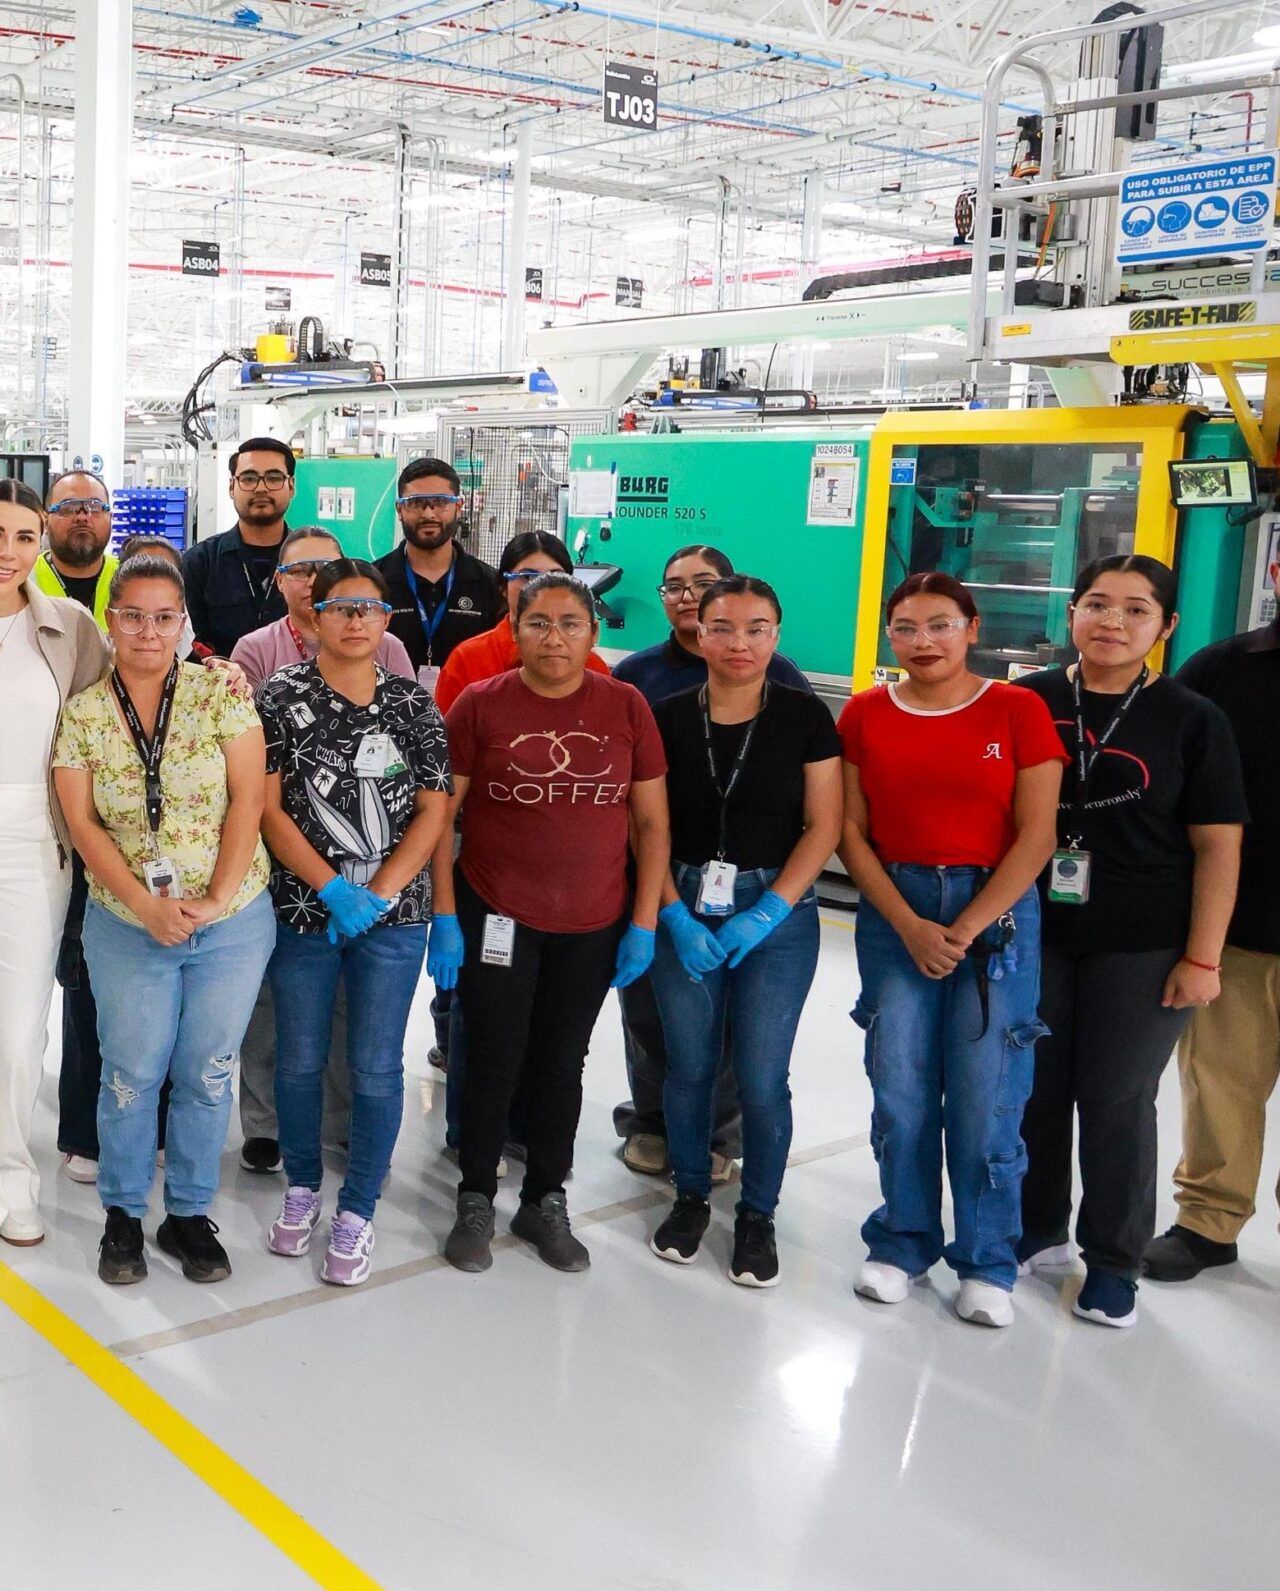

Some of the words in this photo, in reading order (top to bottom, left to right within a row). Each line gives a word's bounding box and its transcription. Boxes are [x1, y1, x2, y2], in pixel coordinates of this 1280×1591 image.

[606, 91, 654, 124] TJ03
[1128, 180, 1149, 189] USO
[1152, 168, 1226, 186] OBLIGATORIO
[1230, 166, 1245, 174] DE
[1248, 162, 1270, 172] EPP
[1128, 189, 1155, 200] PARA
[1158, 184, 1192, 196] SUBIR
[1194, 182, 1202, 190] A
[1206, 179, 1234, 189] ESTA
[1237, 174, 1268, 185] AREA
[183, 256, 219, 271] ASB04
[361, 268, 391, 282] ASB05
[1147, 270, 1267, 292] succes
[525, 282, 540, 294] B06
[1143, 303, 1239, 328] SAFE-T-FAB
[617, 477, 668, 494] BURG
[616, 506, 668, 518] OUNDER
[674, 508, 696, 520] 520
[700, 508, 706, 520] S
[270, 672, 310, 694] Bunny
[982, 743, 1002, 758] A
[488, 782, 627, 804] COFFEE
[1084, 788, 1141, 809] enerously
